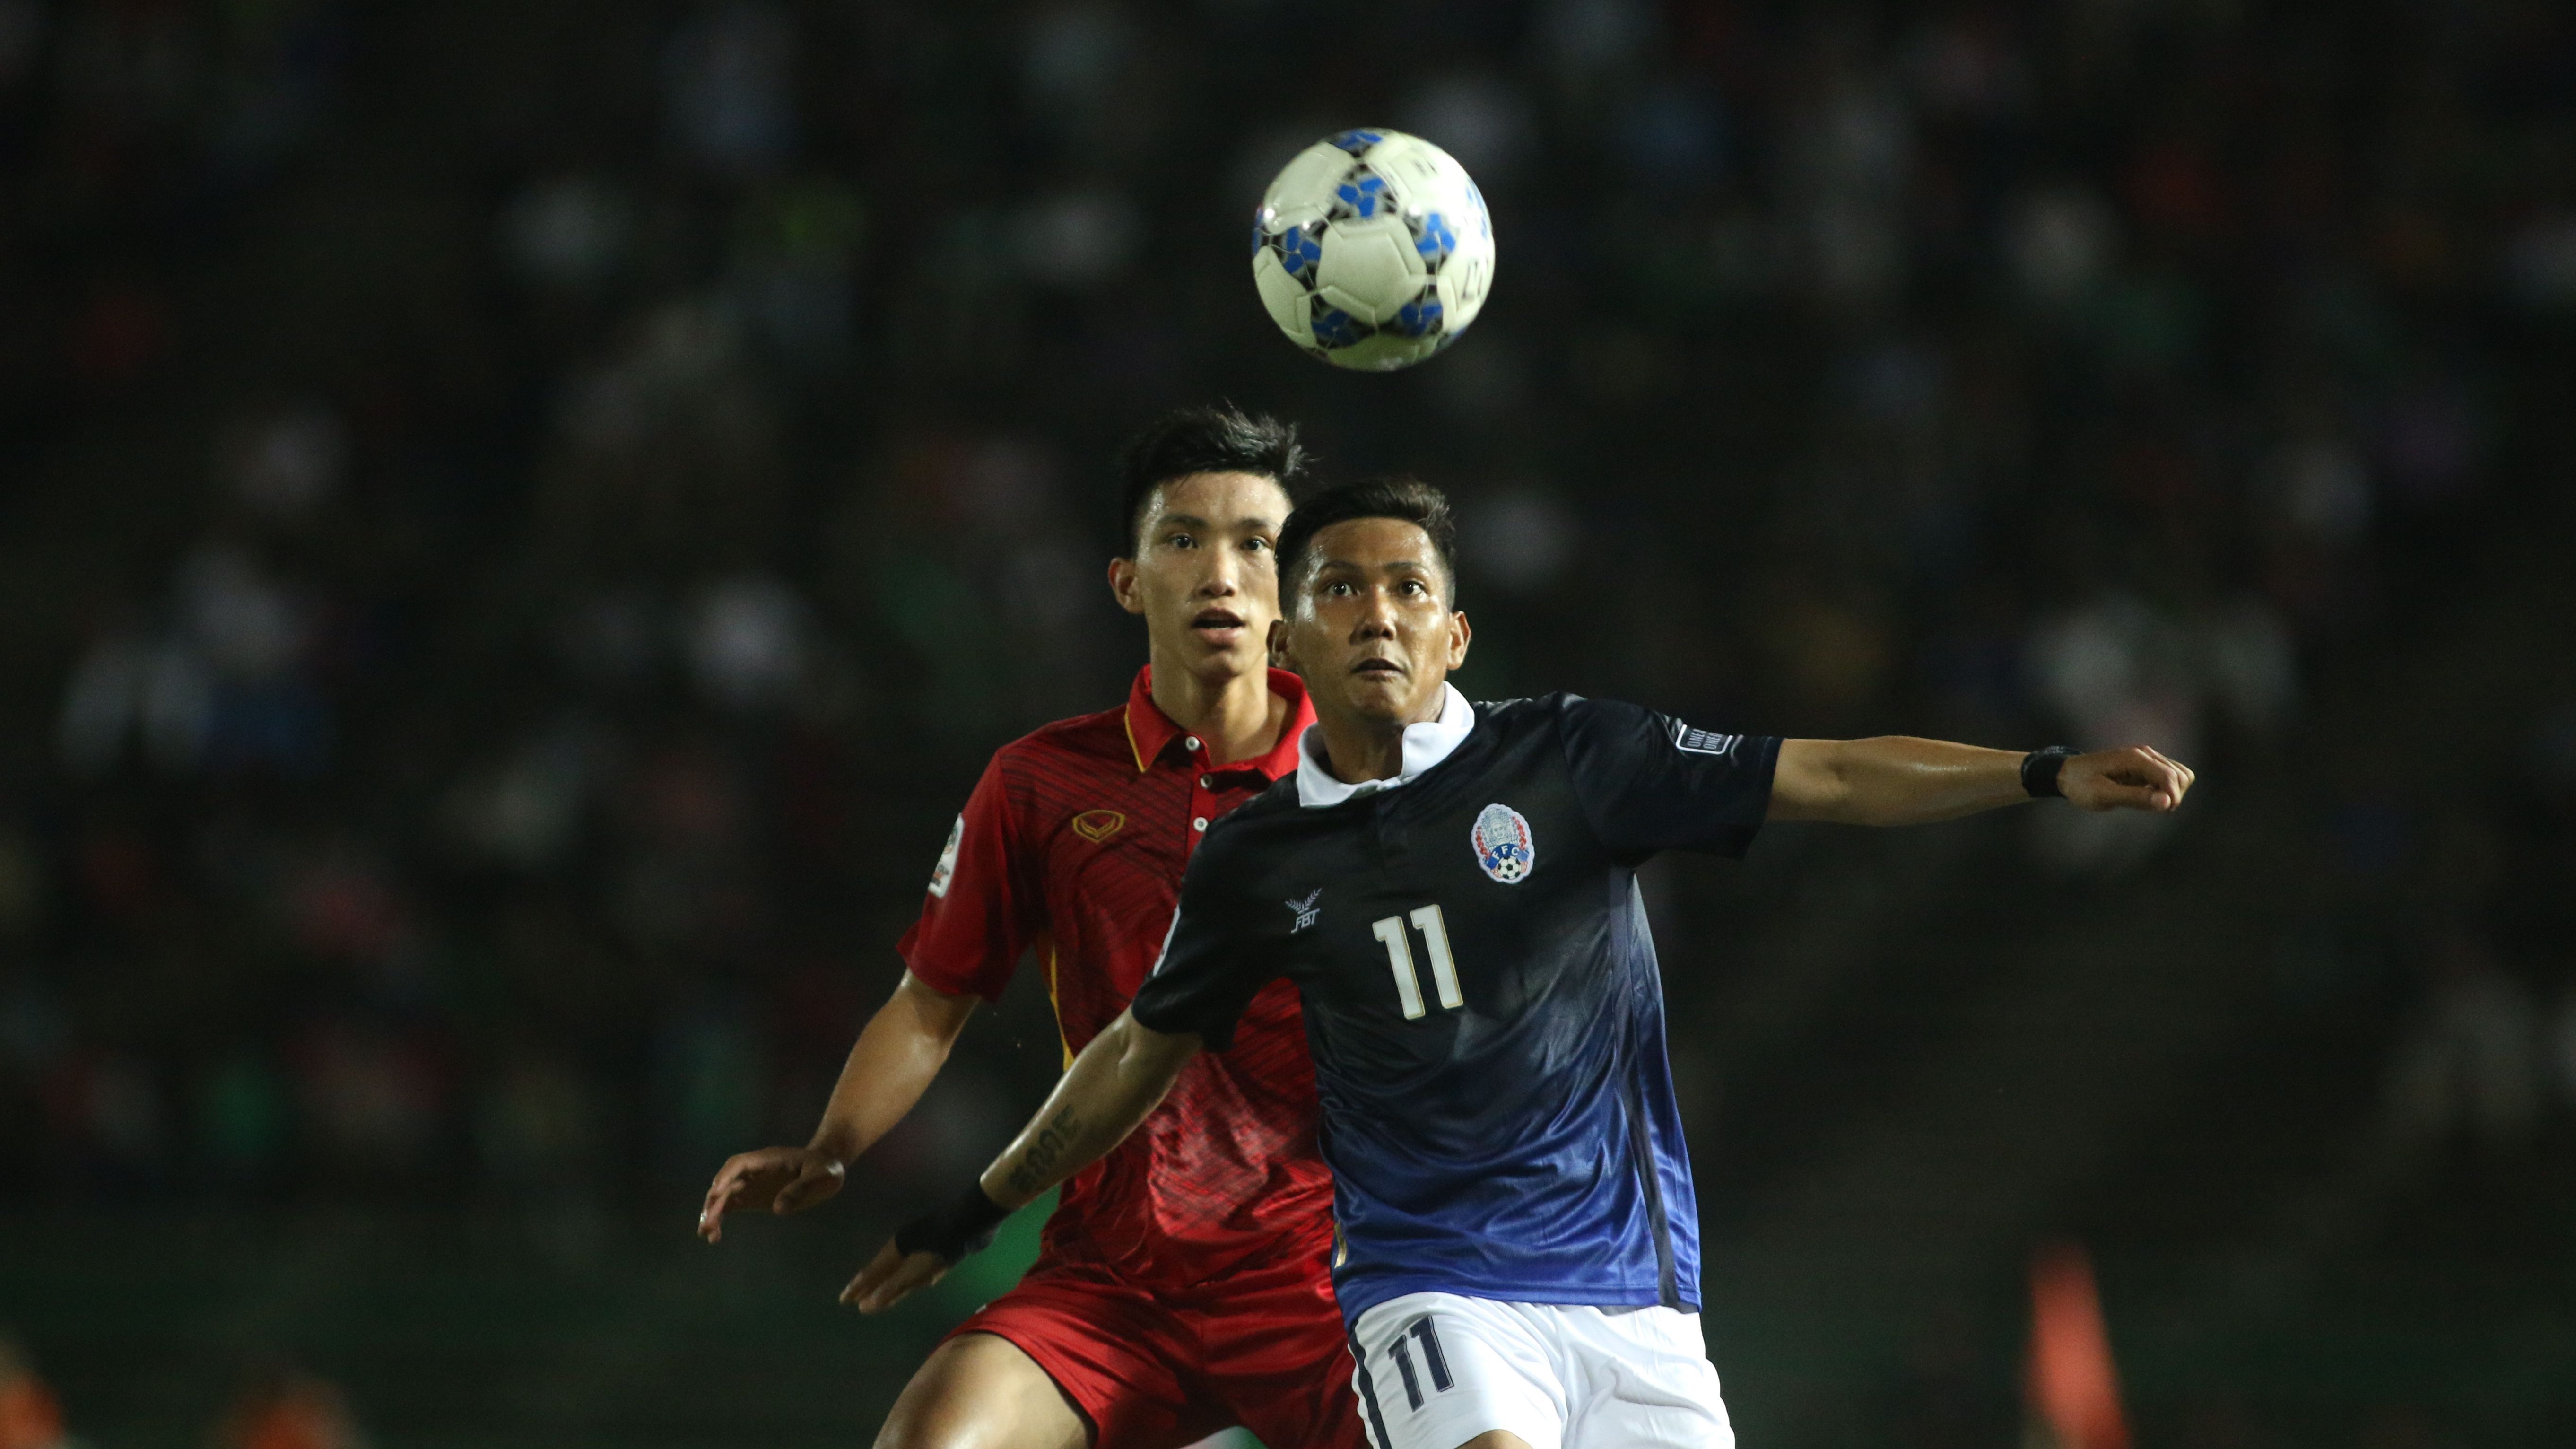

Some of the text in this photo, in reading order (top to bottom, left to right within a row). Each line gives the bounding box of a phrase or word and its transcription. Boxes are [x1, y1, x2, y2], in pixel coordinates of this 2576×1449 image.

[1290, 908, 1321, 934] FBT
[1372, 903, 1464, 1020] 11
[1387, 1315, 1454, 1413] 11
